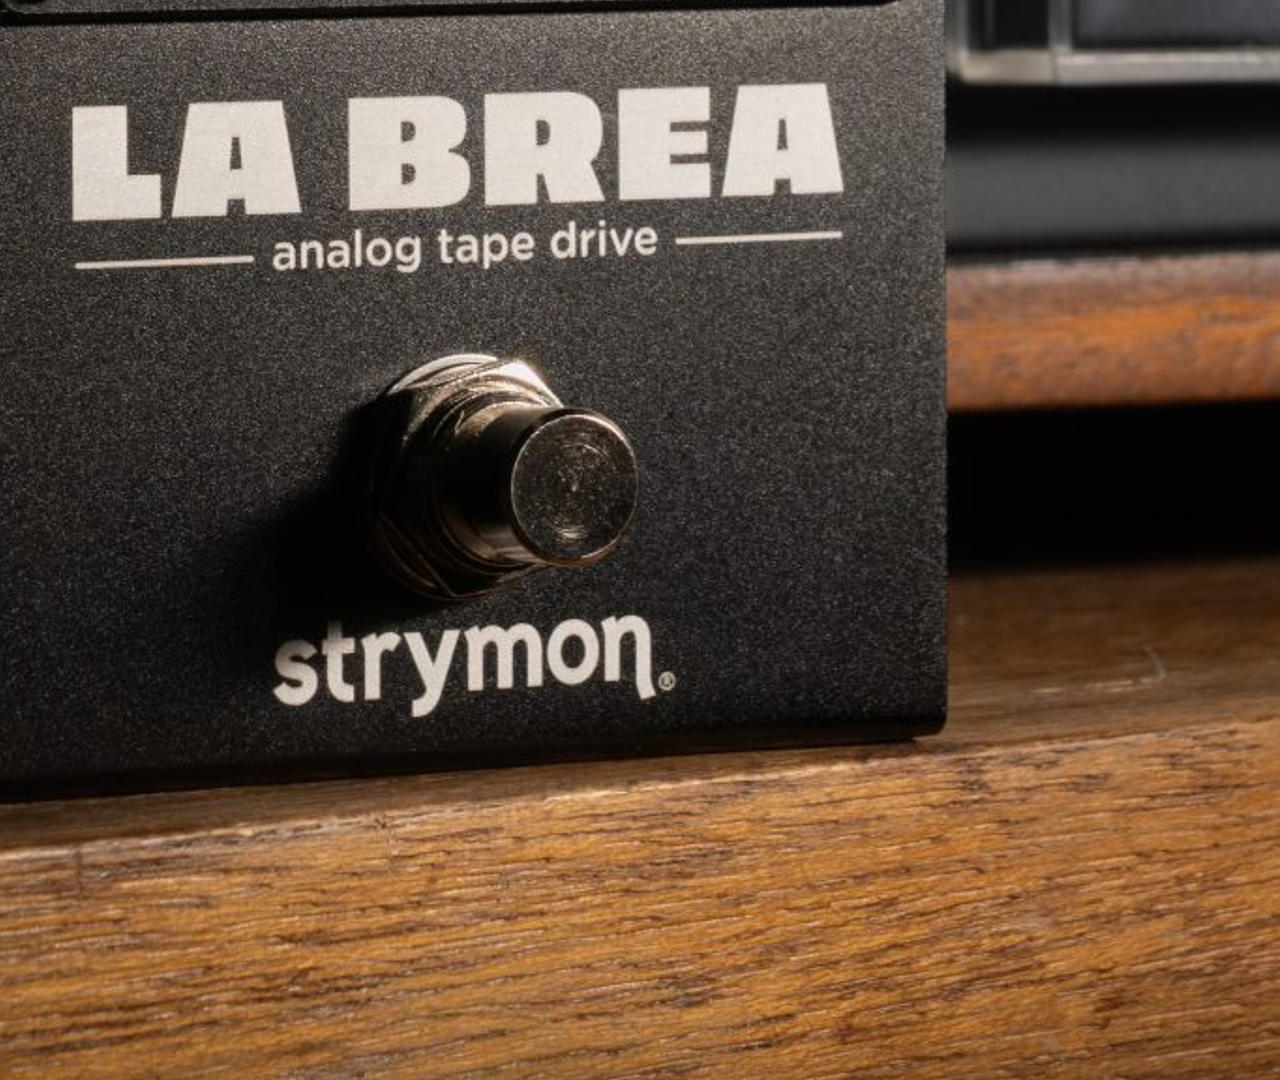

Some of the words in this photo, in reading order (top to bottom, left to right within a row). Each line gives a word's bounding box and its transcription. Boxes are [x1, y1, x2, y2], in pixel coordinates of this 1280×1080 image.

[70, 99, 303, 222] LA
[347, 81, 845, 212] BREA
[271, 225, 422, 274] analog
[439, 224, 537, 267] tape
[550, 219, 660, 260] drive
